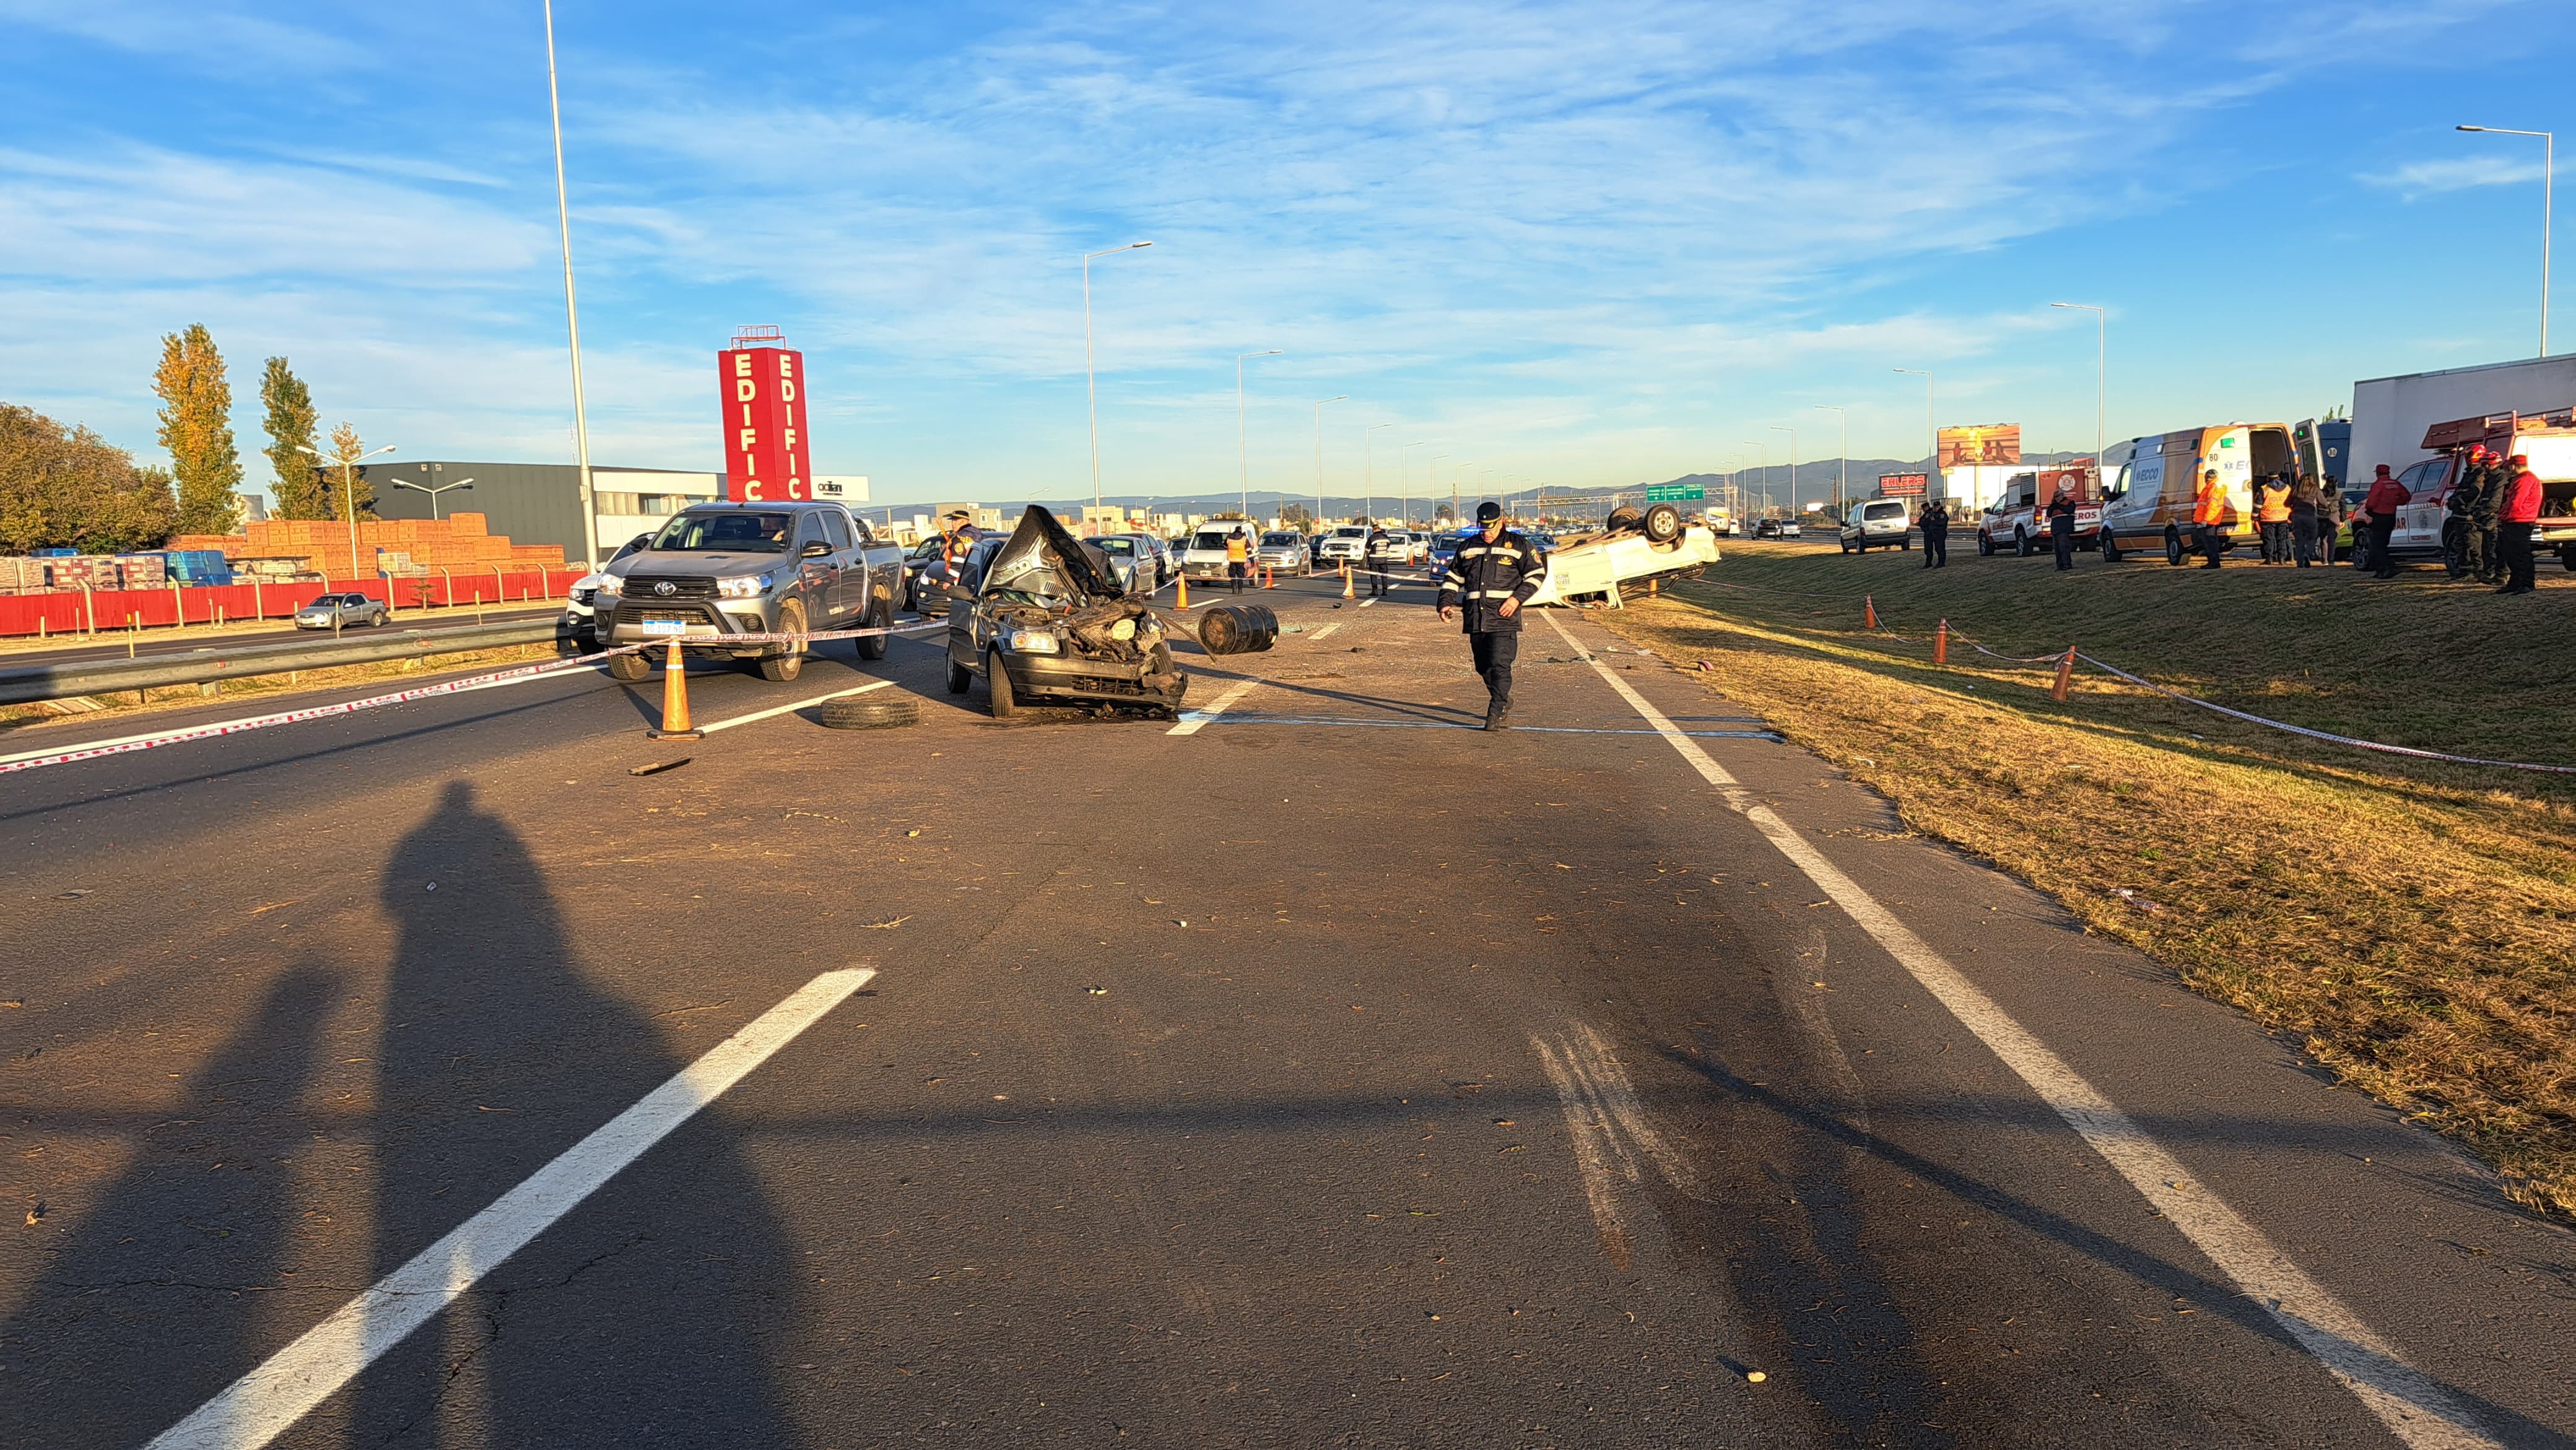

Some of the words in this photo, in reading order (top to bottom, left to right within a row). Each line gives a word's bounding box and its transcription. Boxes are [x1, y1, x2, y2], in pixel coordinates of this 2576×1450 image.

[735, 354, 763, 501] EDIFIC
[780, 355, 801, 500] EDIFIC
[2209, 454, 2218, 462] 80
[1881, 475, 1925, 487] EHLERS
[2140, 467, 2159, 482] ECCO
